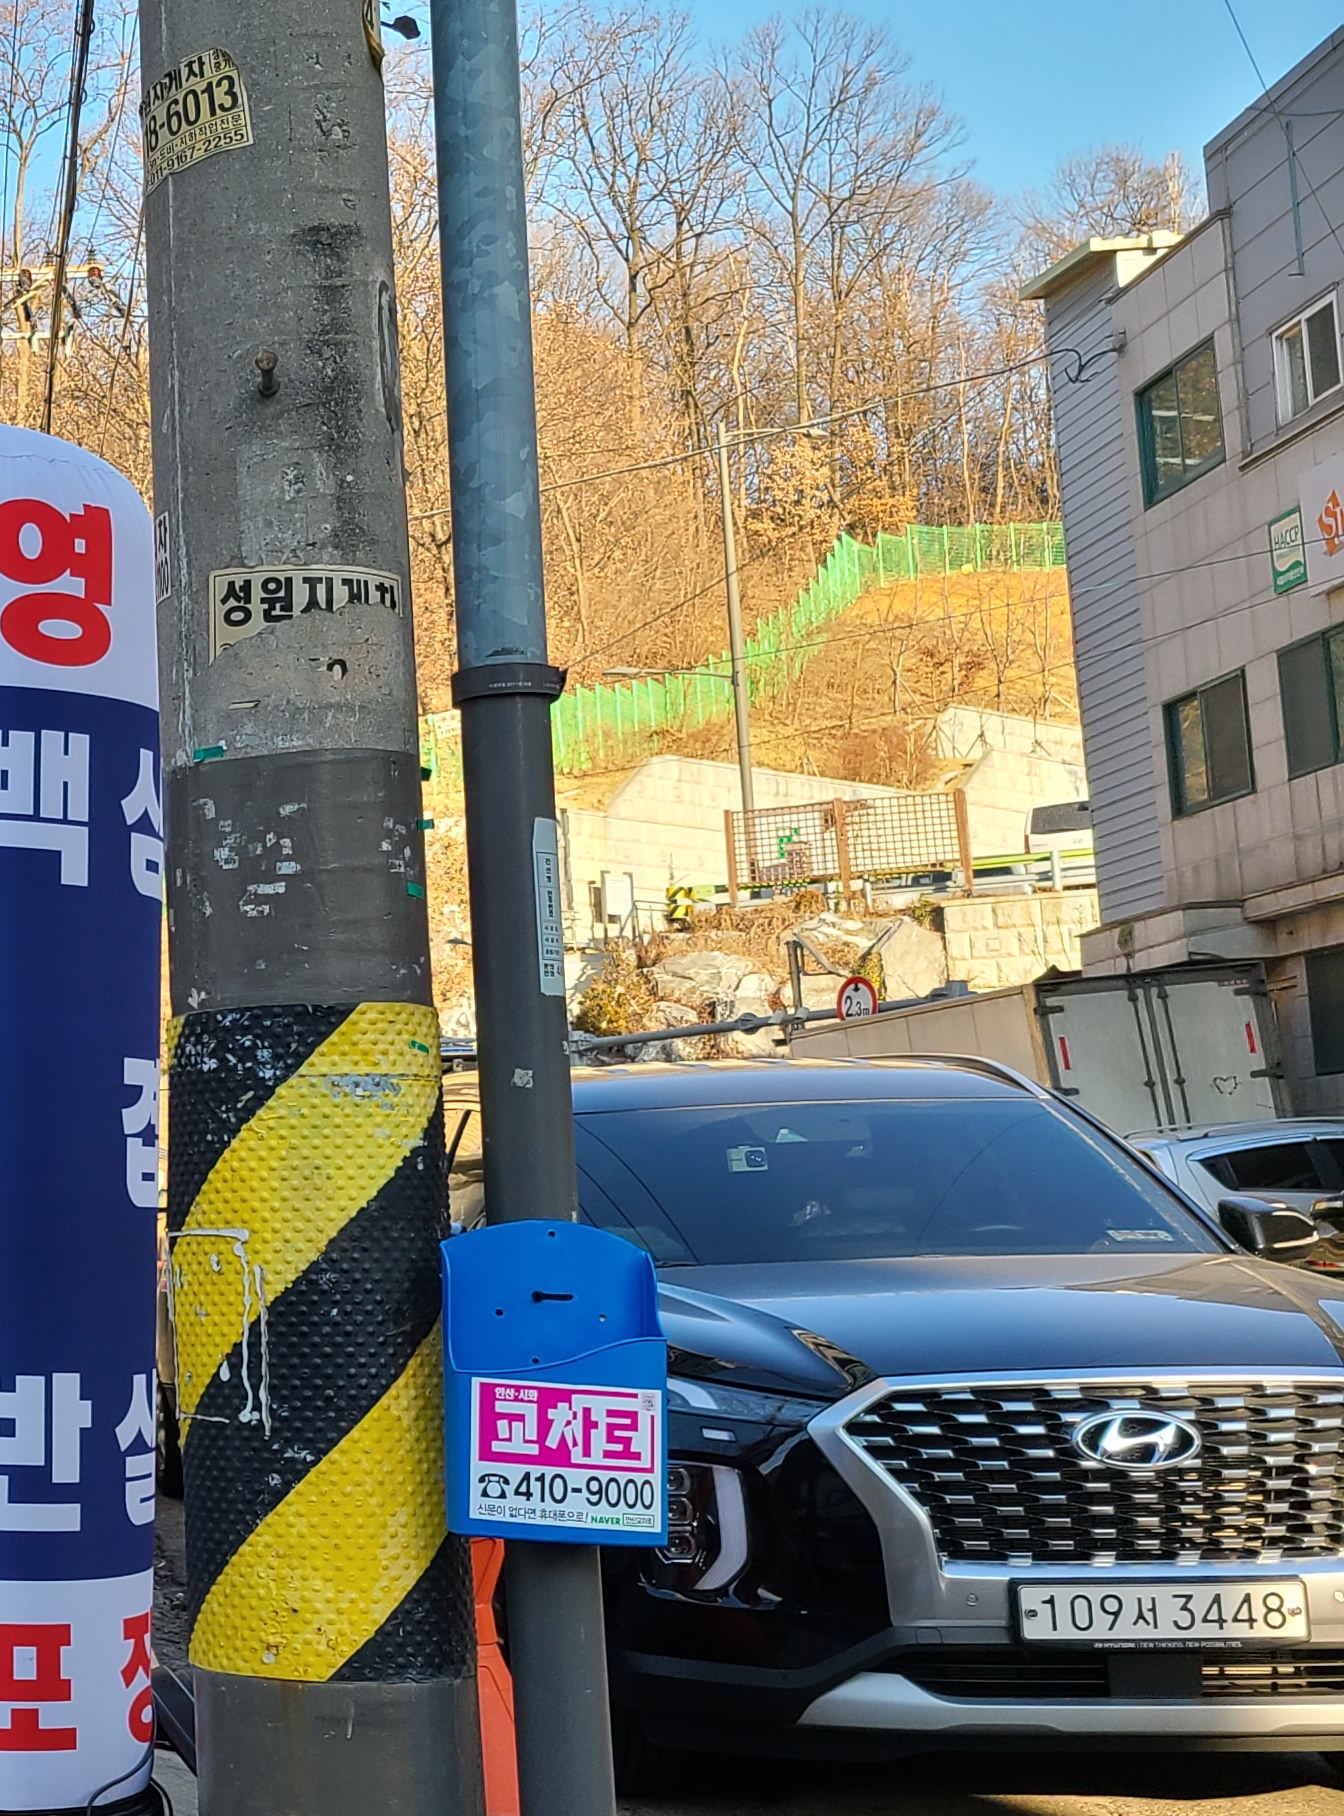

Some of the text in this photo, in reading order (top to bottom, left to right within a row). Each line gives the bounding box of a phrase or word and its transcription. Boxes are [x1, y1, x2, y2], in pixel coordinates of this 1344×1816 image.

[1274, 525, 1300, 549] HACCP
[844, 995, 870, 1018] 2.3m
[491, 1398, 643, 1463] 교차로
[514, 1471, 655, 1511] 410-9000
[477, 1503, 589, 1524] 신문이 없다면 휴대폰으로!
[590, 1515, 621, 1526] NAVER
